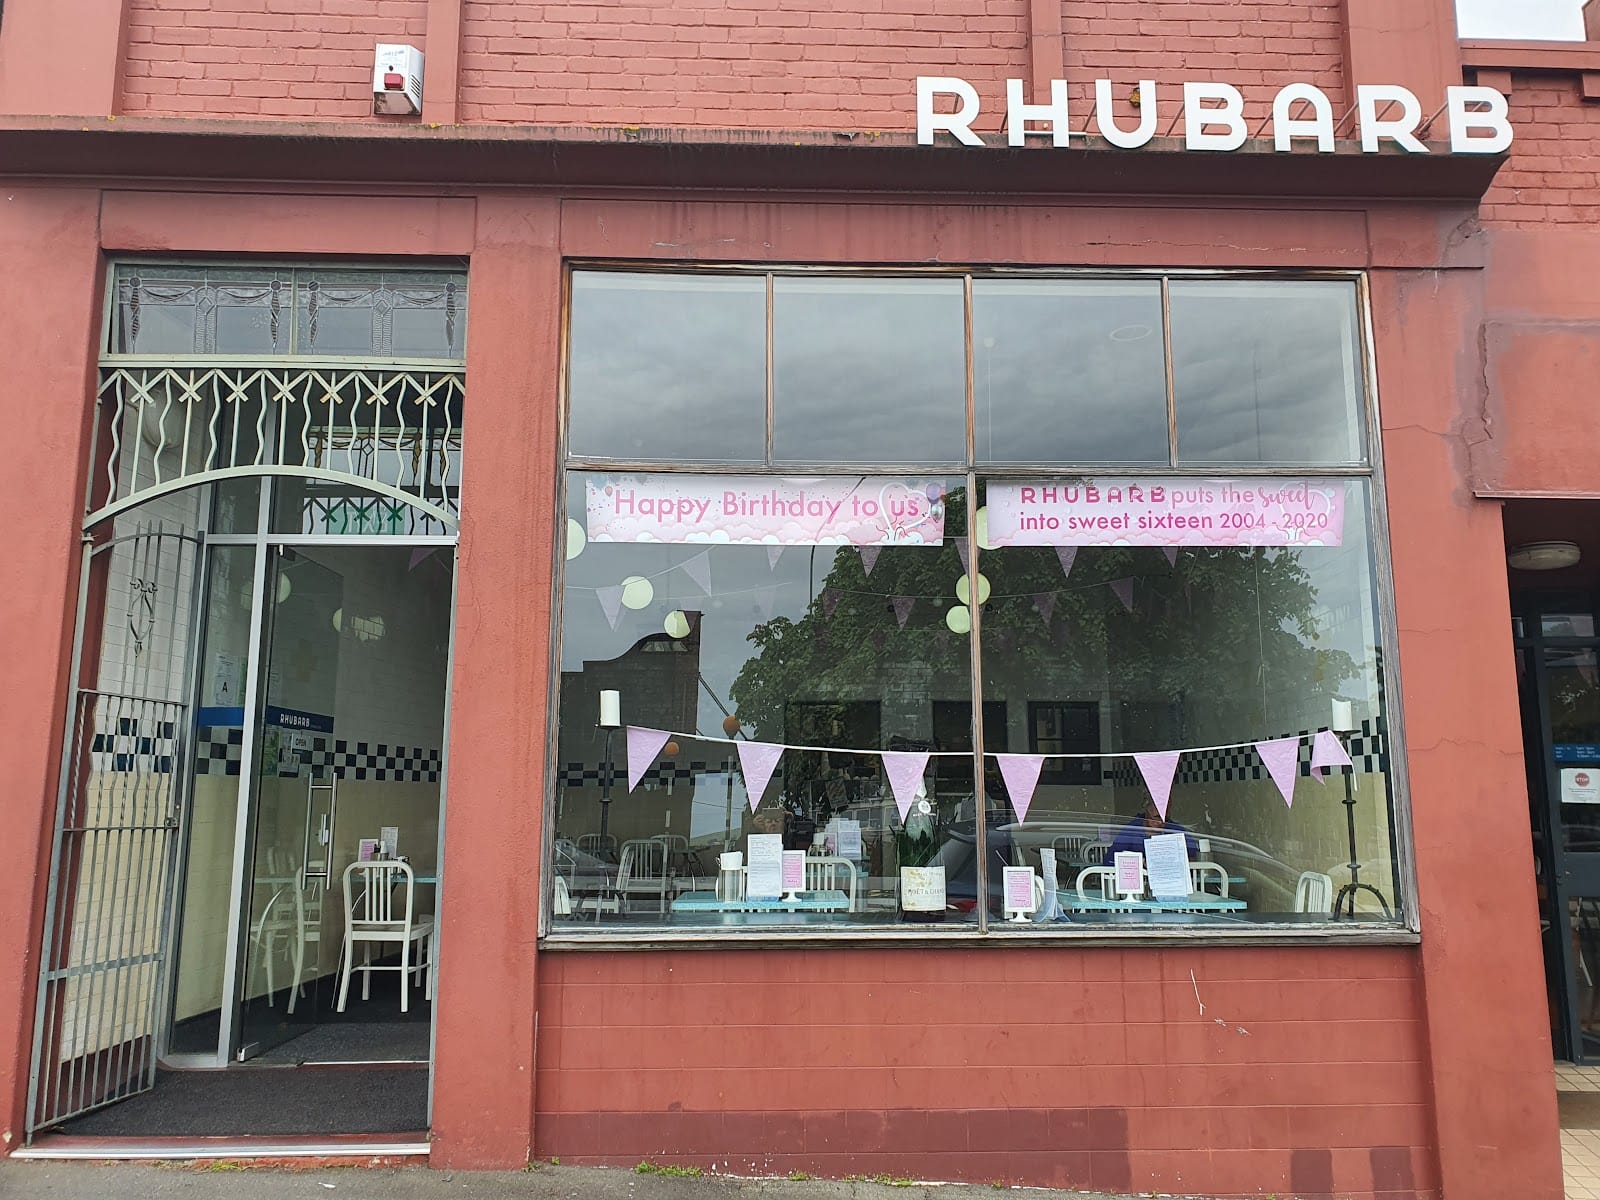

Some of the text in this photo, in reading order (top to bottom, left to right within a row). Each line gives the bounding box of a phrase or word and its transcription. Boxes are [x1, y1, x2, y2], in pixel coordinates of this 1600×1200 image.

[916, 76, 1514, 154] RHUBARB
[614, 490, 919, 524] Happy Birthday to us
[1020, 482, 1316, 510] RHUBARB puts the sweet
[1019, 511, 1060, 530] into
[1068, 513, 1130, 530] sweet
[1138, 511, 1213, 530] sixteen
[1220, 512, 1266, 529] 2004
[1282, 512, 1328, 529] 2020
[279, 713, 310, 728] RHUBARB
